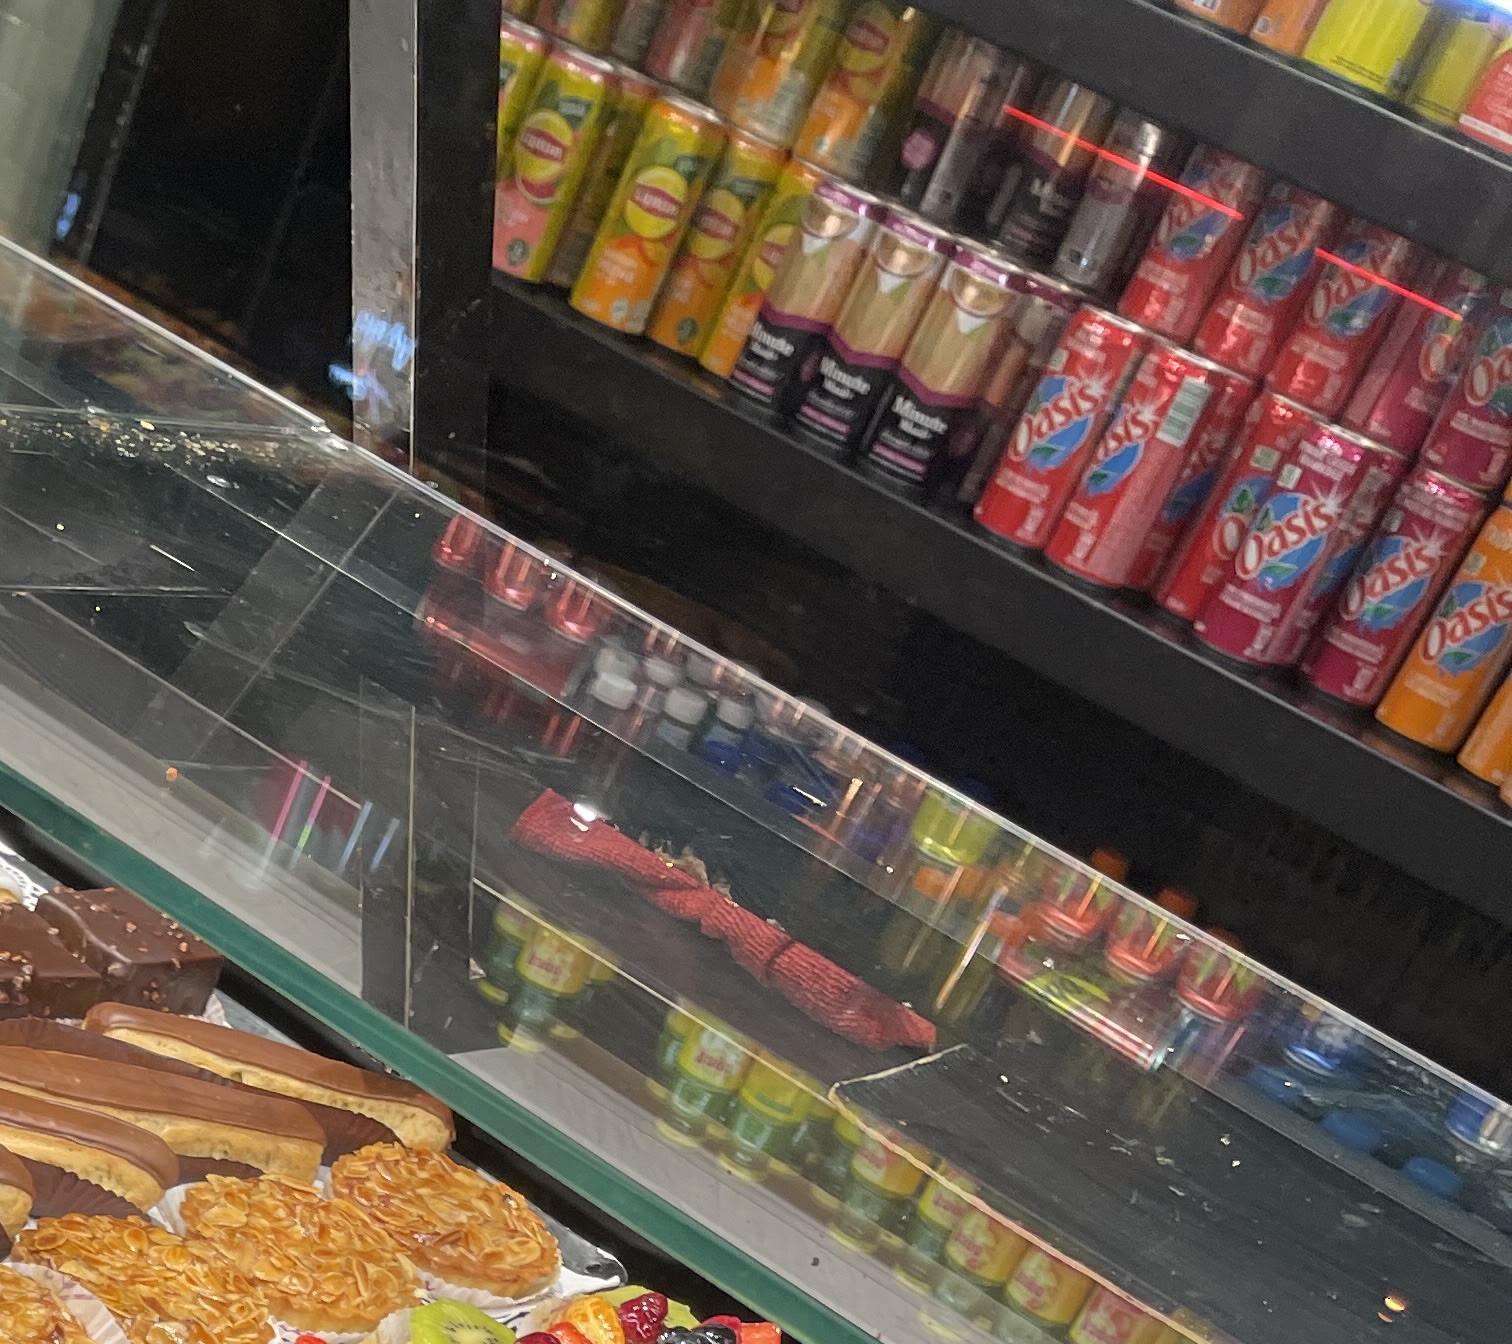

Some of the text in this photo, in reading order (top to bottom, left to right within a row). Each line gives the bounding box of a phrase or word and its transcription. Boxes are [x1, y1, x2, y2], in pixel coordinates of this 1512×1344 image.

[1008, 377, 1105, 463] Oasis
[1094, 400, 1158, 466] asis
[1235, 495, 1337, 582] Oasis
[1339, 538, 1440, 622] Oasis
